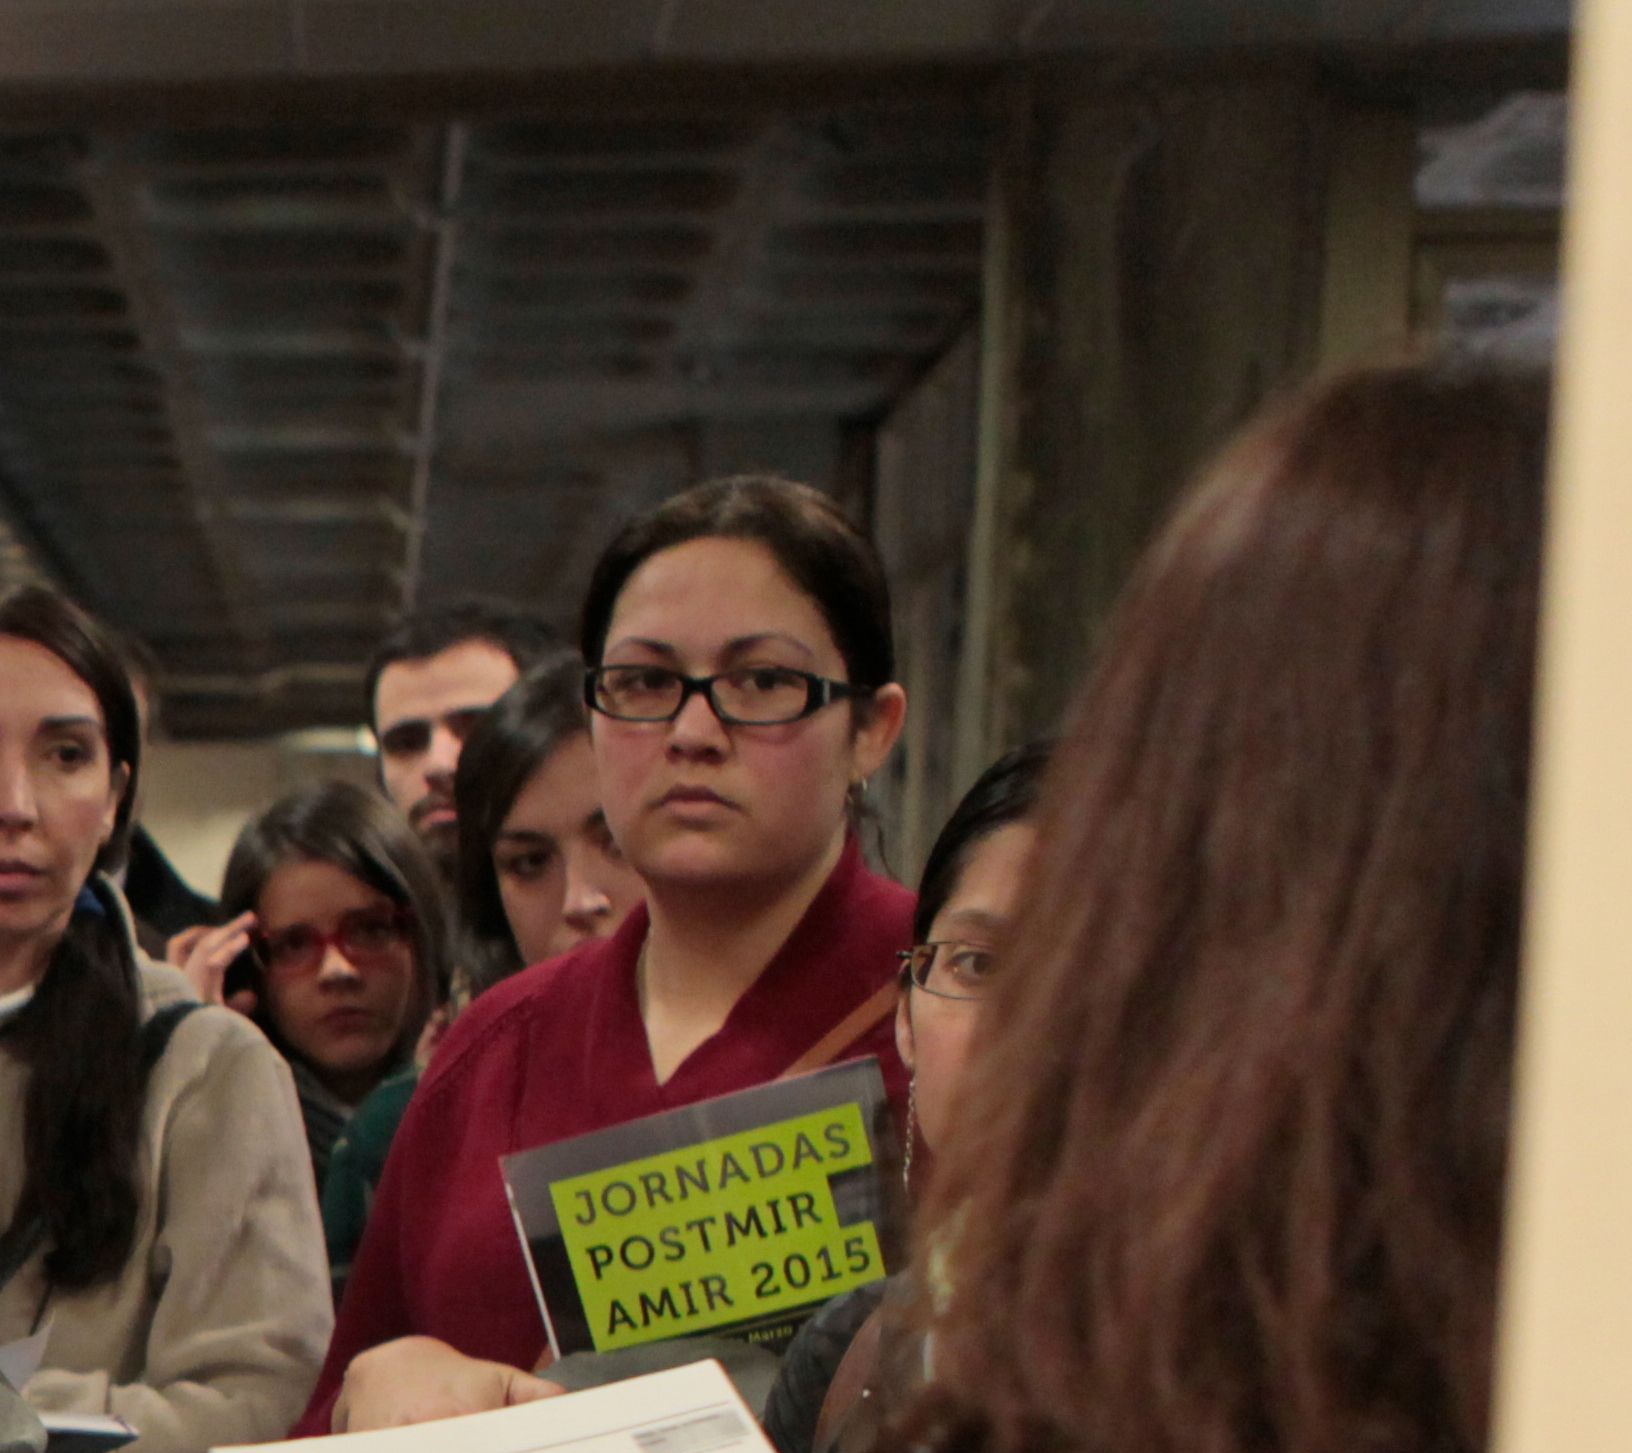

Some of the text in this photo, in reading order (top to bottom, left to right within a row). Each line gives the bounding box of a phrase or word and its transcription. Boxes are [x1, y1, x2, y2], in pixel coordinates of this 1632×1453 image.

[573, 1124, 851, 1226] JORNADAS
[585, 1191, 823, 1280] POSTMIR
[607, 1237, 871, 1336] AMIR 2015
